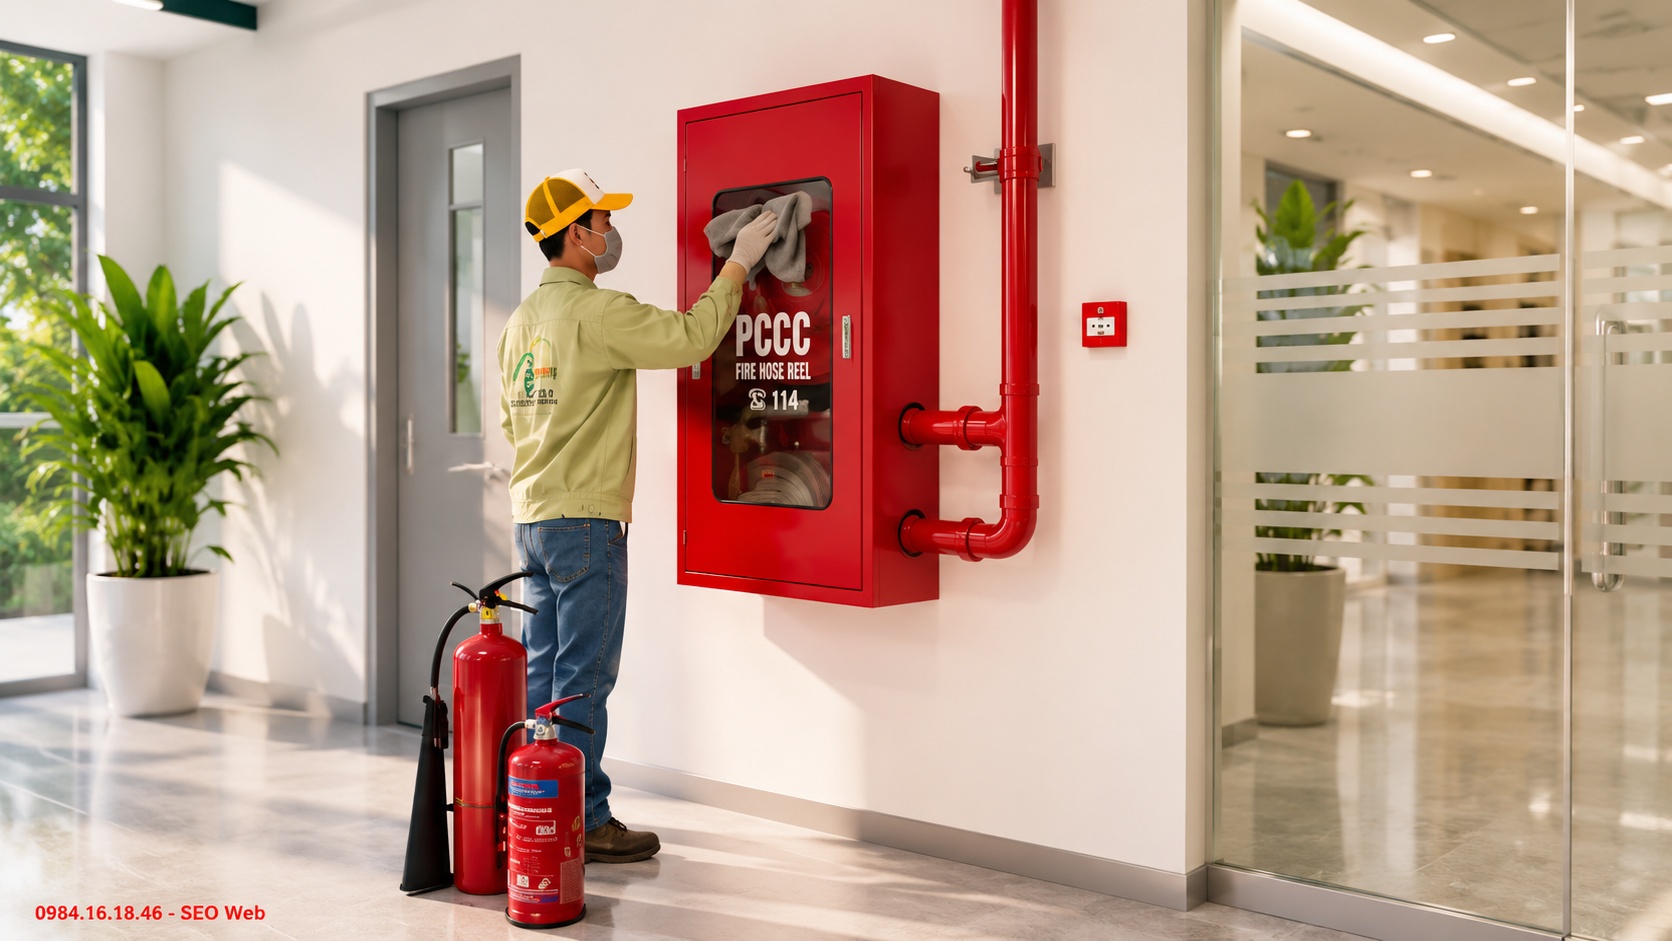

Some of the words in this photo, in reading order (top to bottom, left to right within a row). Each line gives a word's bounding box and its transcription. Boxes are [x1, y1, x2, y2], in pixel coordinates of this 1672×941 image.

[736, 311, 811, 357] PCCC
[735, 362, 757, 380] FIRE
[759, 362, 785, 380] HOSE
[787, 362, 811, 380] REEL
[772, 389, 799, 411] 114
